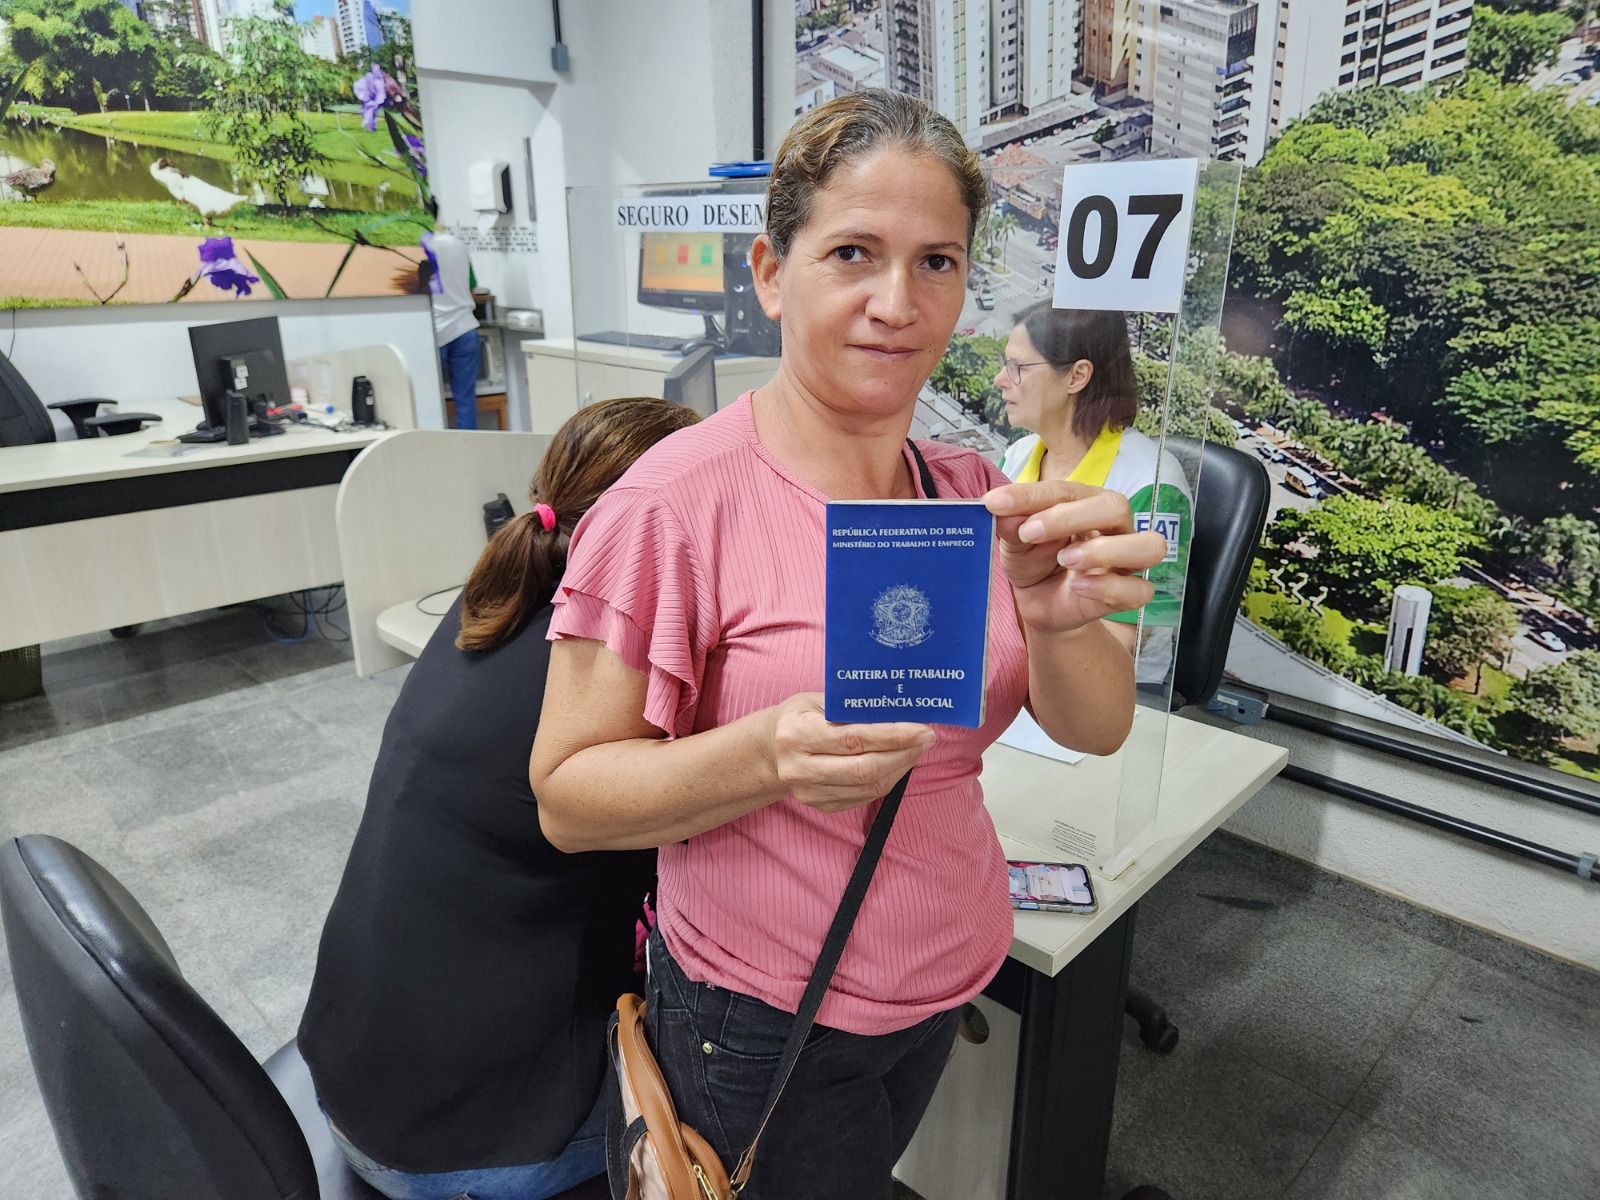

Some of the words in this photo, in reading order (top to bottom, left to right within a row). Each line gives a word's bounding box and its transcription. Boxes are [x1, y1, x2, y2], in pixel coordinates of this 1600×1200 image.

[618, 205, 689, 226] SEGURO
[1067, 194, 1183, 279] 07
[832, 527, 877, 536] REPÚBLICA
[879, 528, 928, 536] FEDERATIVA
[930, 527, 944, 535] DO
[946, 527, 974, 535] BRASIL
[832, 540, 876, 548] MINISTÉRIO
[877, 540, 890, 548] DO
[891, 540, 931, 548] TRABALHO
[837, 669, 888, 680] CARTEIRA
[891, 669, 905, 679] DE
[908, 669, 965, 680] TRABALHO
[897, 684, 904, 693] E
[844, 695, 913, 708] PREVIDÊNCIA
[915, 698, 954, 708] SOCIAL
